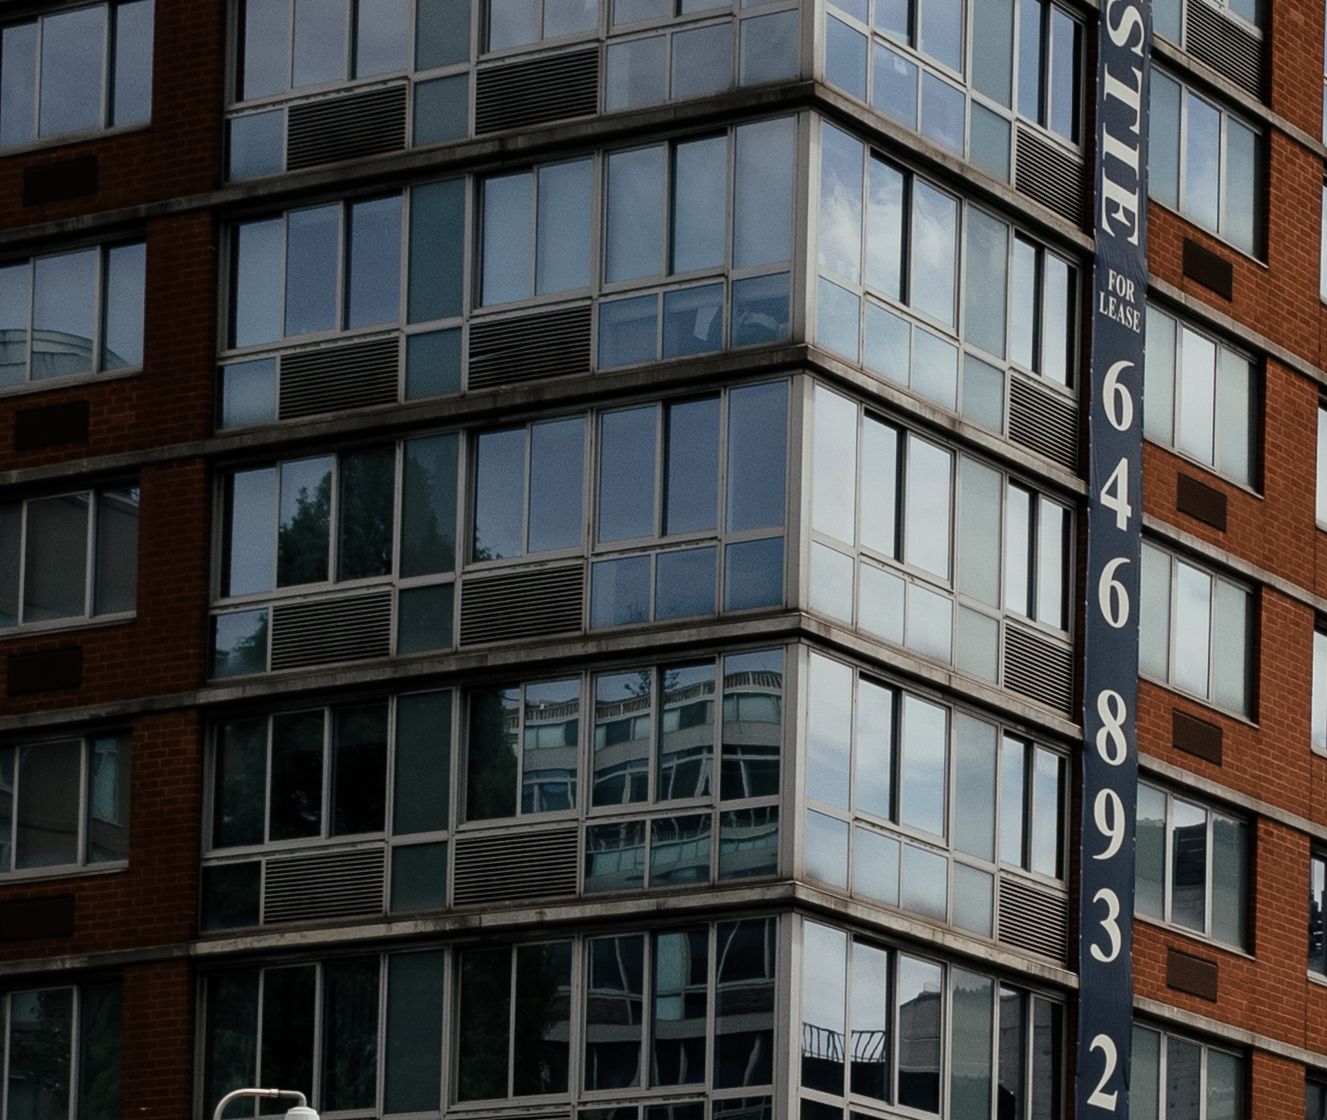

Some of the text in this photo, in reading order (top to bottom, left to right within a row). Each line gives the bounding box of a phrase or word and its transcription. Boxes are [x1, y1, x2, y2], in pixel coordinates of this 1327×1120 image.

[1099, 291, 1141, 333] LEASE
[1107, 268, 1135, 304] FOR
[1098, 359, 1135, 630] 646
[1089, 689, 1128, 964] 893
